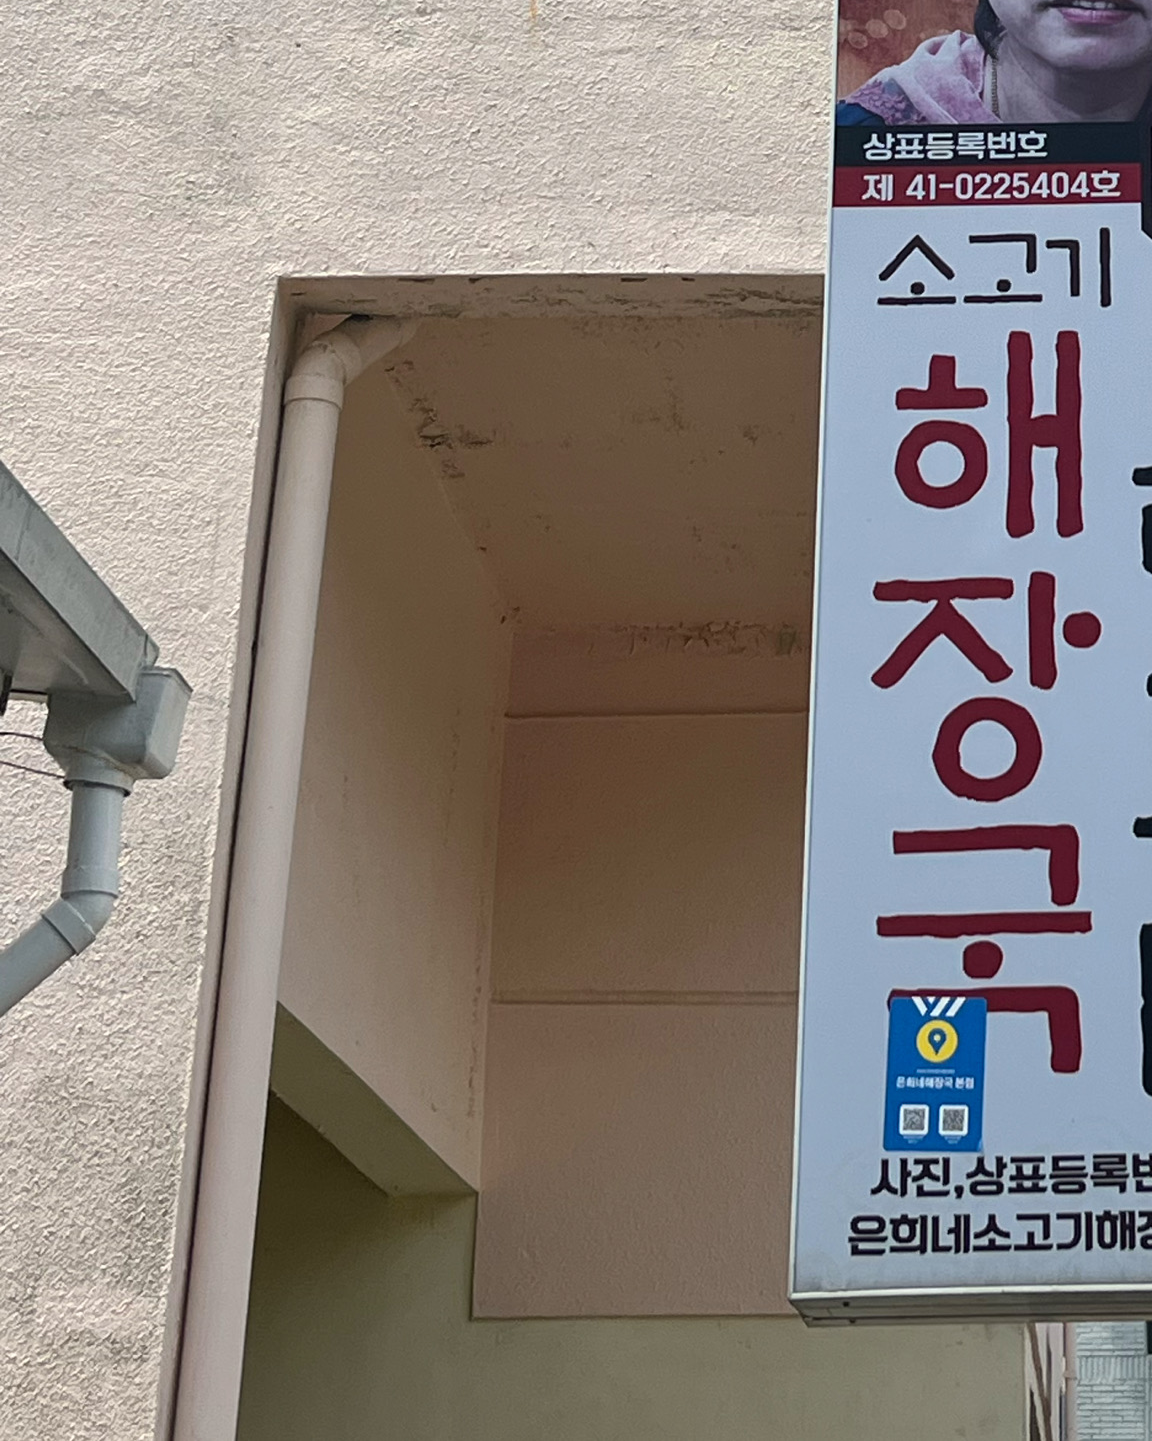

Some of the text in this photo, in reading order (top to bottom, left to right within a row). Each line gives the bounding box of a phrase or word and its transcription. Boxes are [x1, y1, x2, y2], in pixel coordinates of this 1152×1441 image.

[863, 130, 1048, 161] 상표등록번호
[861, 170, 1122, 202] 제 41-0225404호
[876, 227, 1112, 308] 소고기
[870, 330, 1102, 1074] 해장국
